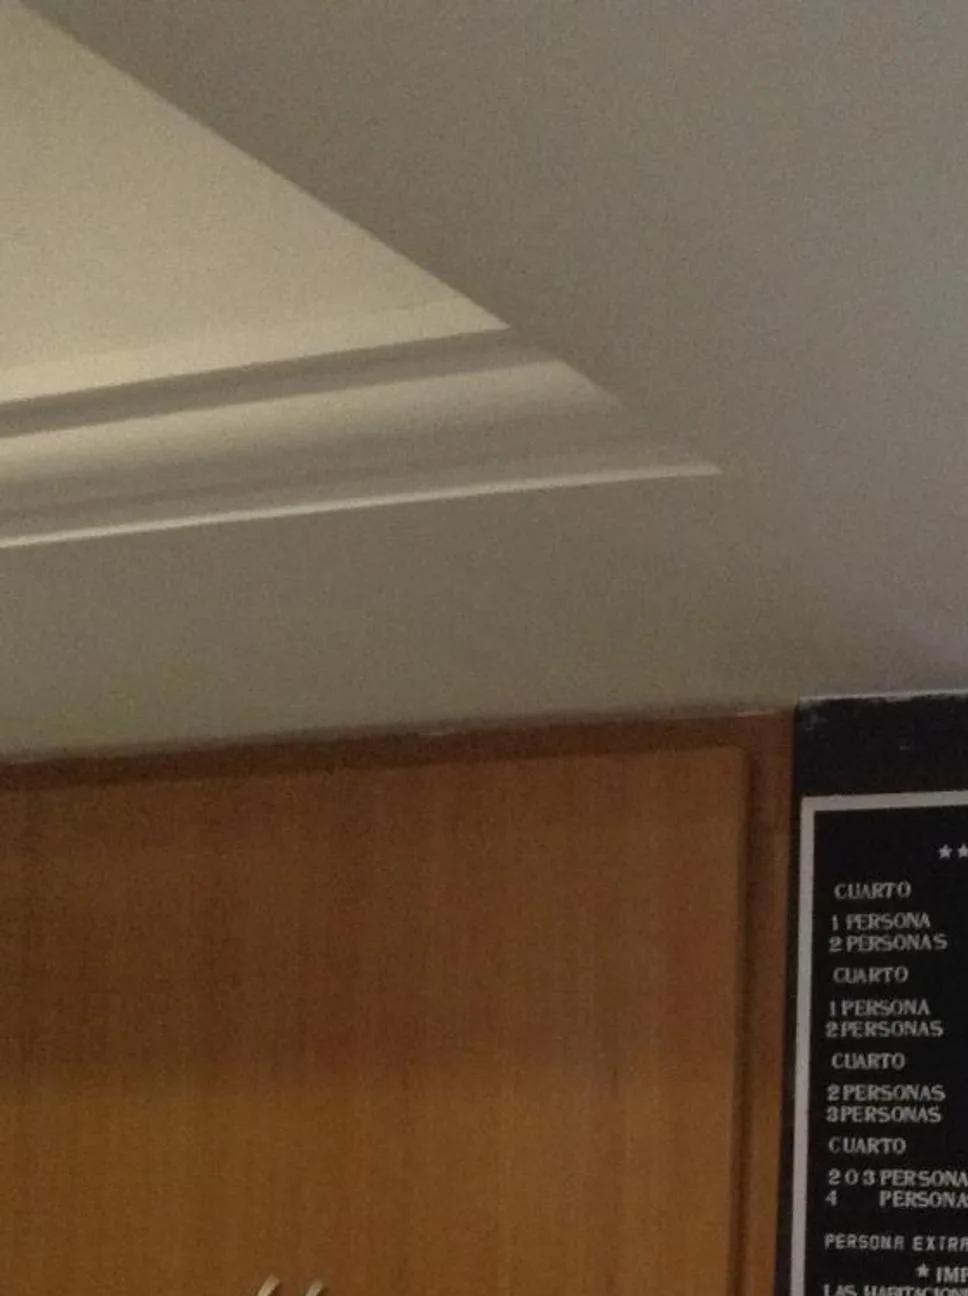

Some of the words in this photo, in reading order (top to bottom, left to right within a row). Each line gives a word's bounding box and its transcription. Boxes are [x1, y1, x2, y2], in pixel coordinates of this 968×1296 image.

[834, 881, 911, 899] CUARTO
[832, 914, 838, 931] 1
[845, 912, 931, 930] PERSONA
[829, 935, 842, 952] 2
[846, 933, 948, 951] PERSONAS
[833, 965, 909, 983] CUARTO
[841, 998, 930, 1017] PERSONA
[840, 1020, 944, 1038] PERSONAS
[831, 1052, 905, 1070] CUARTO
[842, 1083, 946, 1102] PERSONAS
[840, 1106, 942, 1123] PERSONAS
[828, 1137, 907, 1154] CUARTO
[828, 1168, 840, 1185] 2
[862, 1169, 875, 1185] 3
[826, 1190, 837, 1207] 4
[825, 1233, 905, 1251] PERSONA
